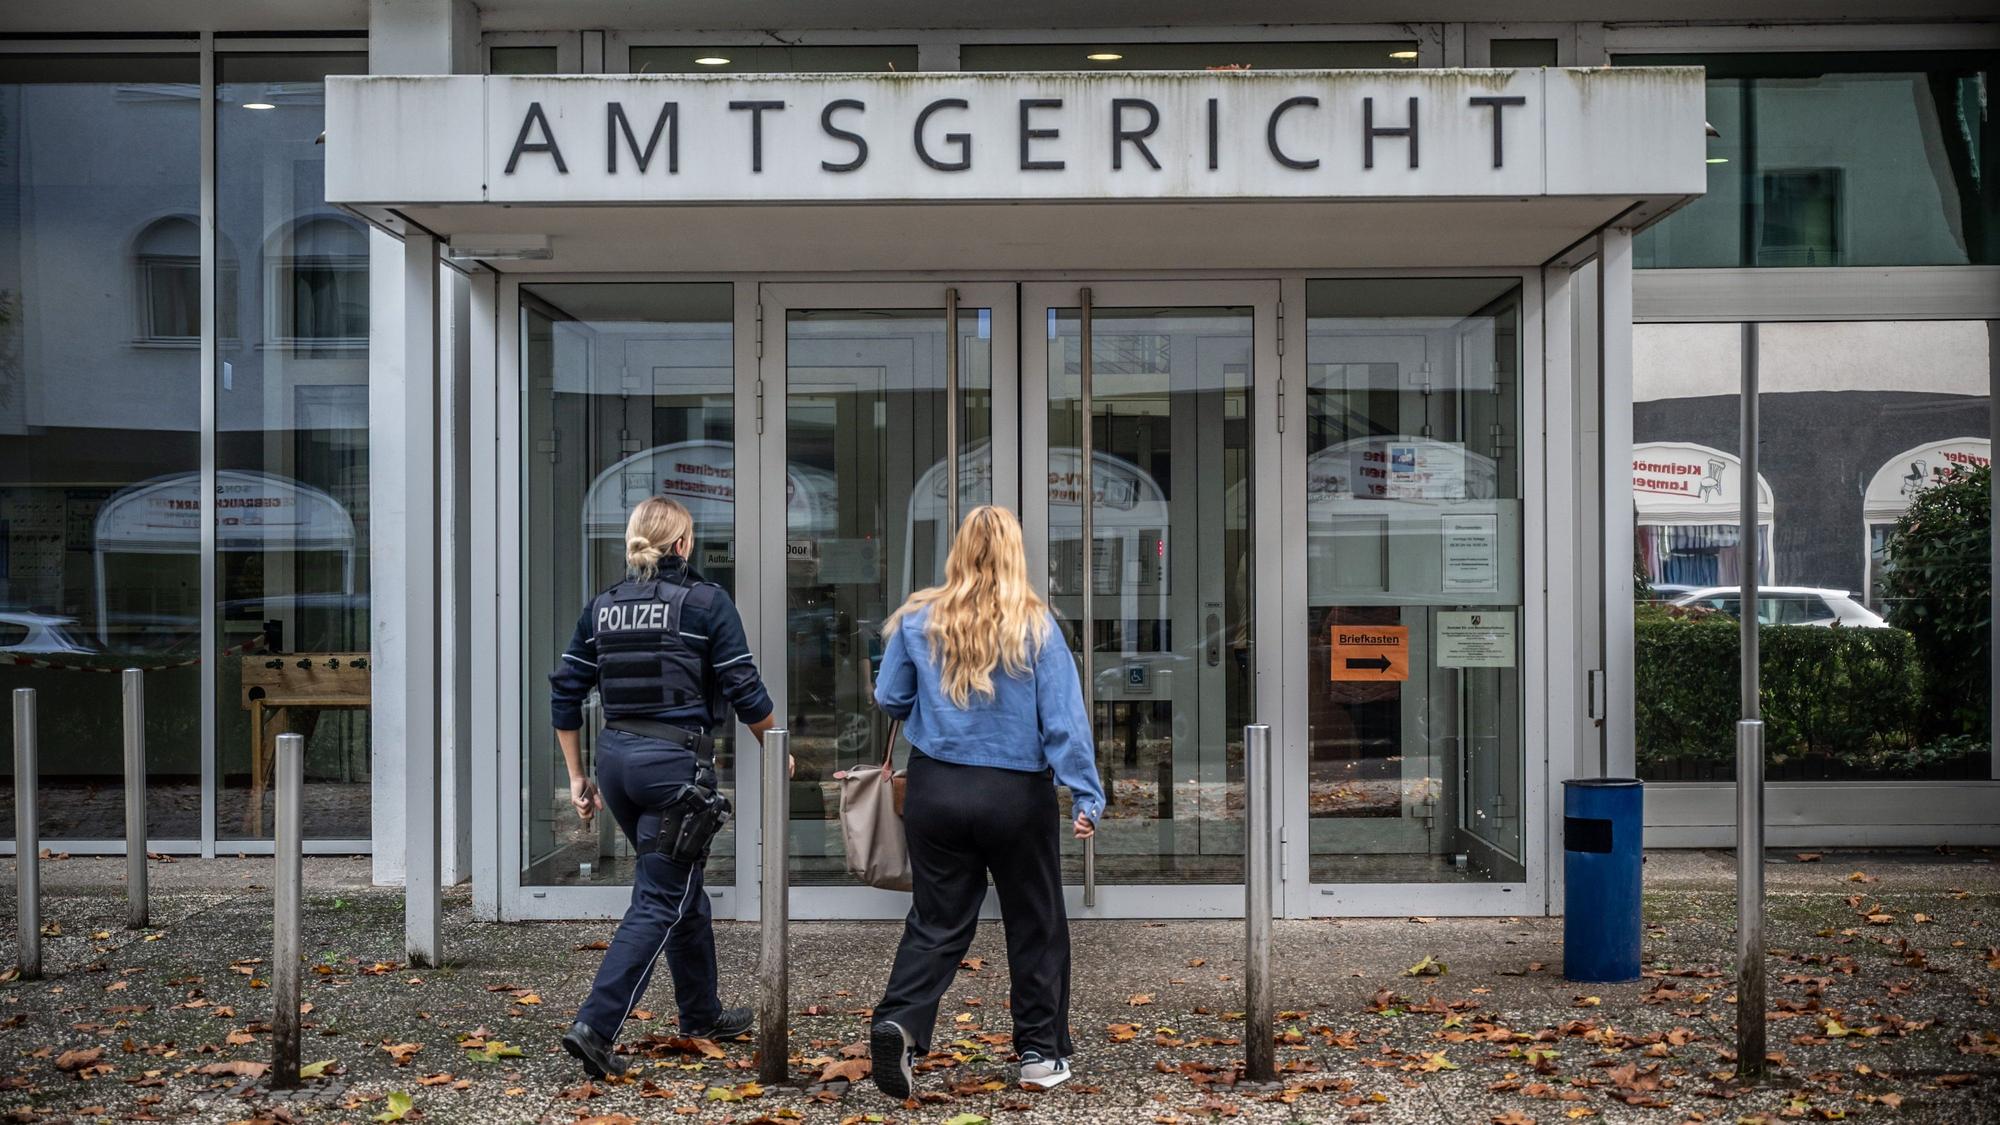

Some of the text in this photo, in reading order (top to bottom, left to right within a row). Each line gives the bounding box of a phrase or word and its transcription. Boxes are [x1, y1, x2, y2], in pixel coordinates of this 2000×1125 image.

[504, 96, 1526, 174] AMTSGERICHT
[597, 603, 670, 632] POLIZEI
[1339, 634, 1400, 644] Briefkasten
